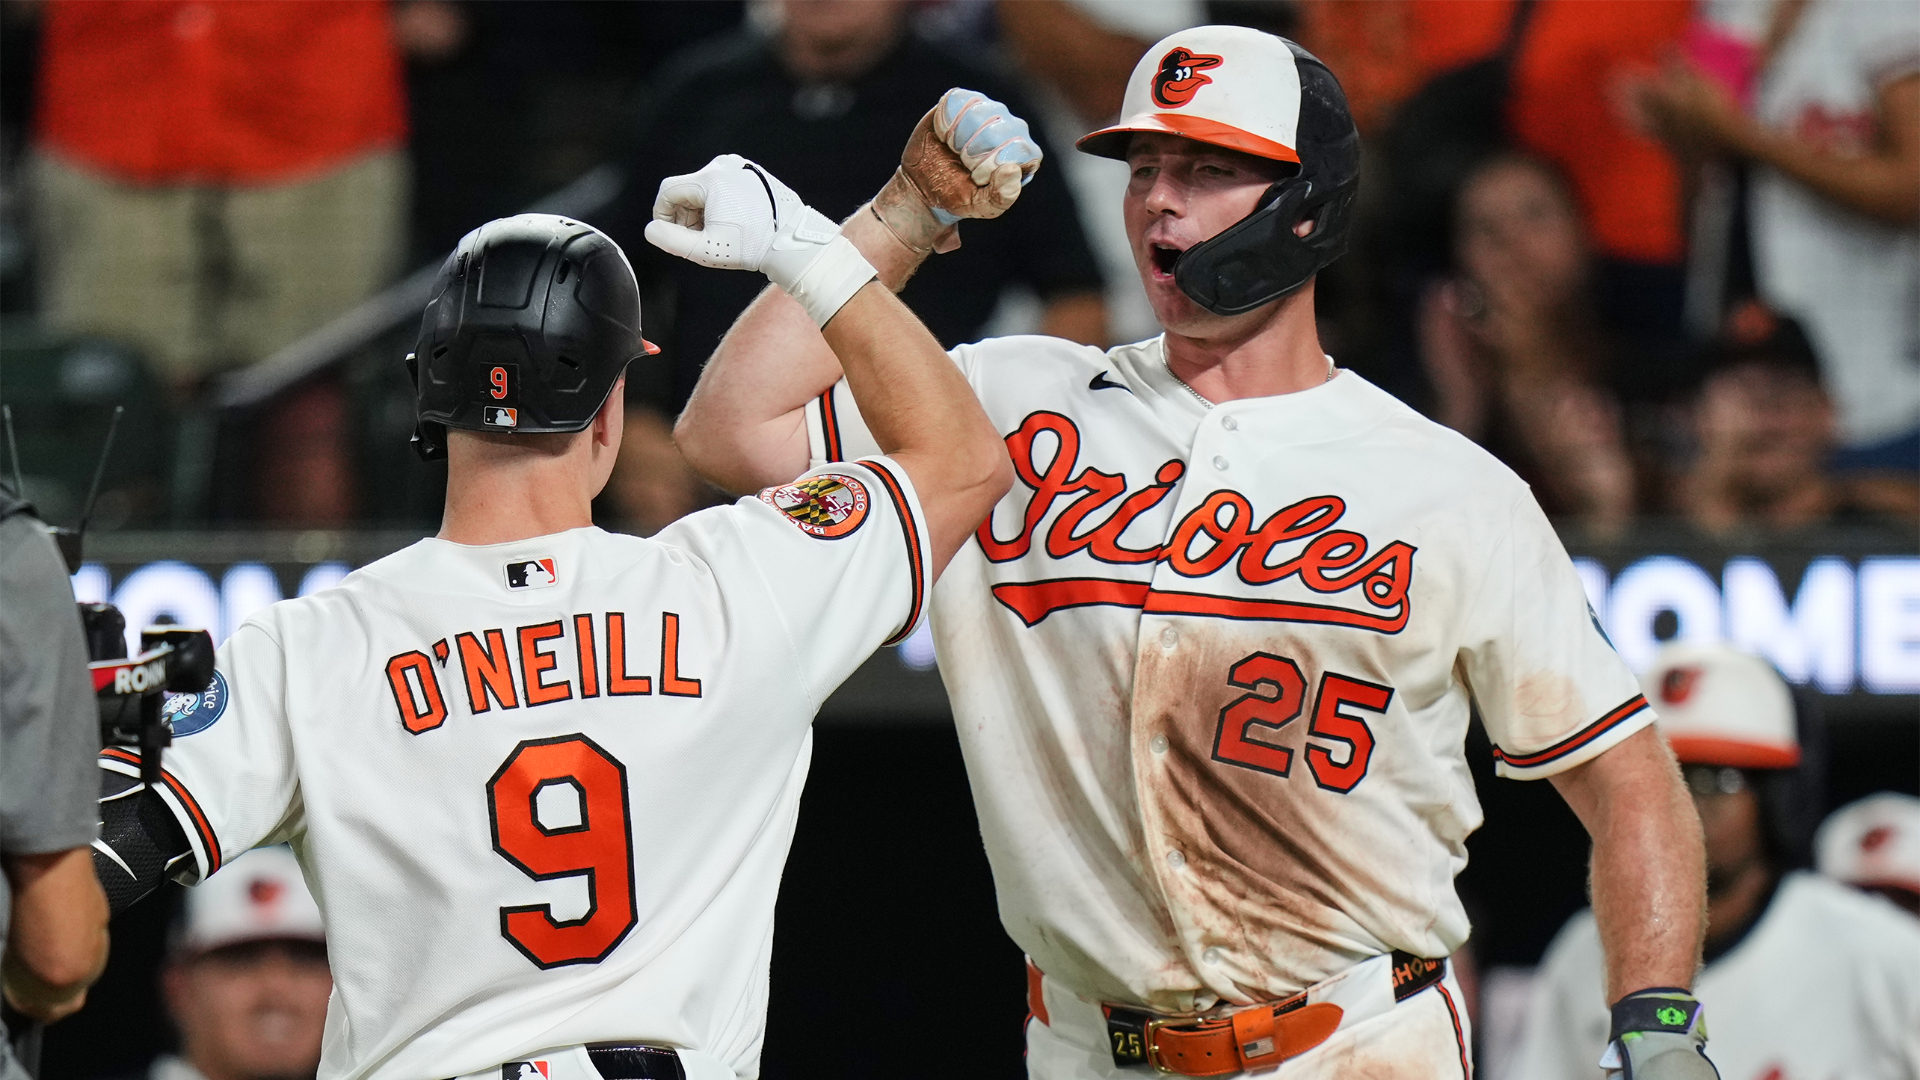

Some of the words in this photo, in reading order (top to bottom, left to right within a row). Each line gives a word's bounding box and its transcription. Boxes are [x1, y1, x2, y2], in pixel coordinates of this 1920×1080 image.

[490, 366, 508, 399] 9
[975, 410, 1417, 607] Orioles
[385, 612, 702, 735] O'NEILL
[1211, 651, 1395, 795] 25
[485, 732, 639, 971] 9
[1113, 1032, 1141, 1058] 25
